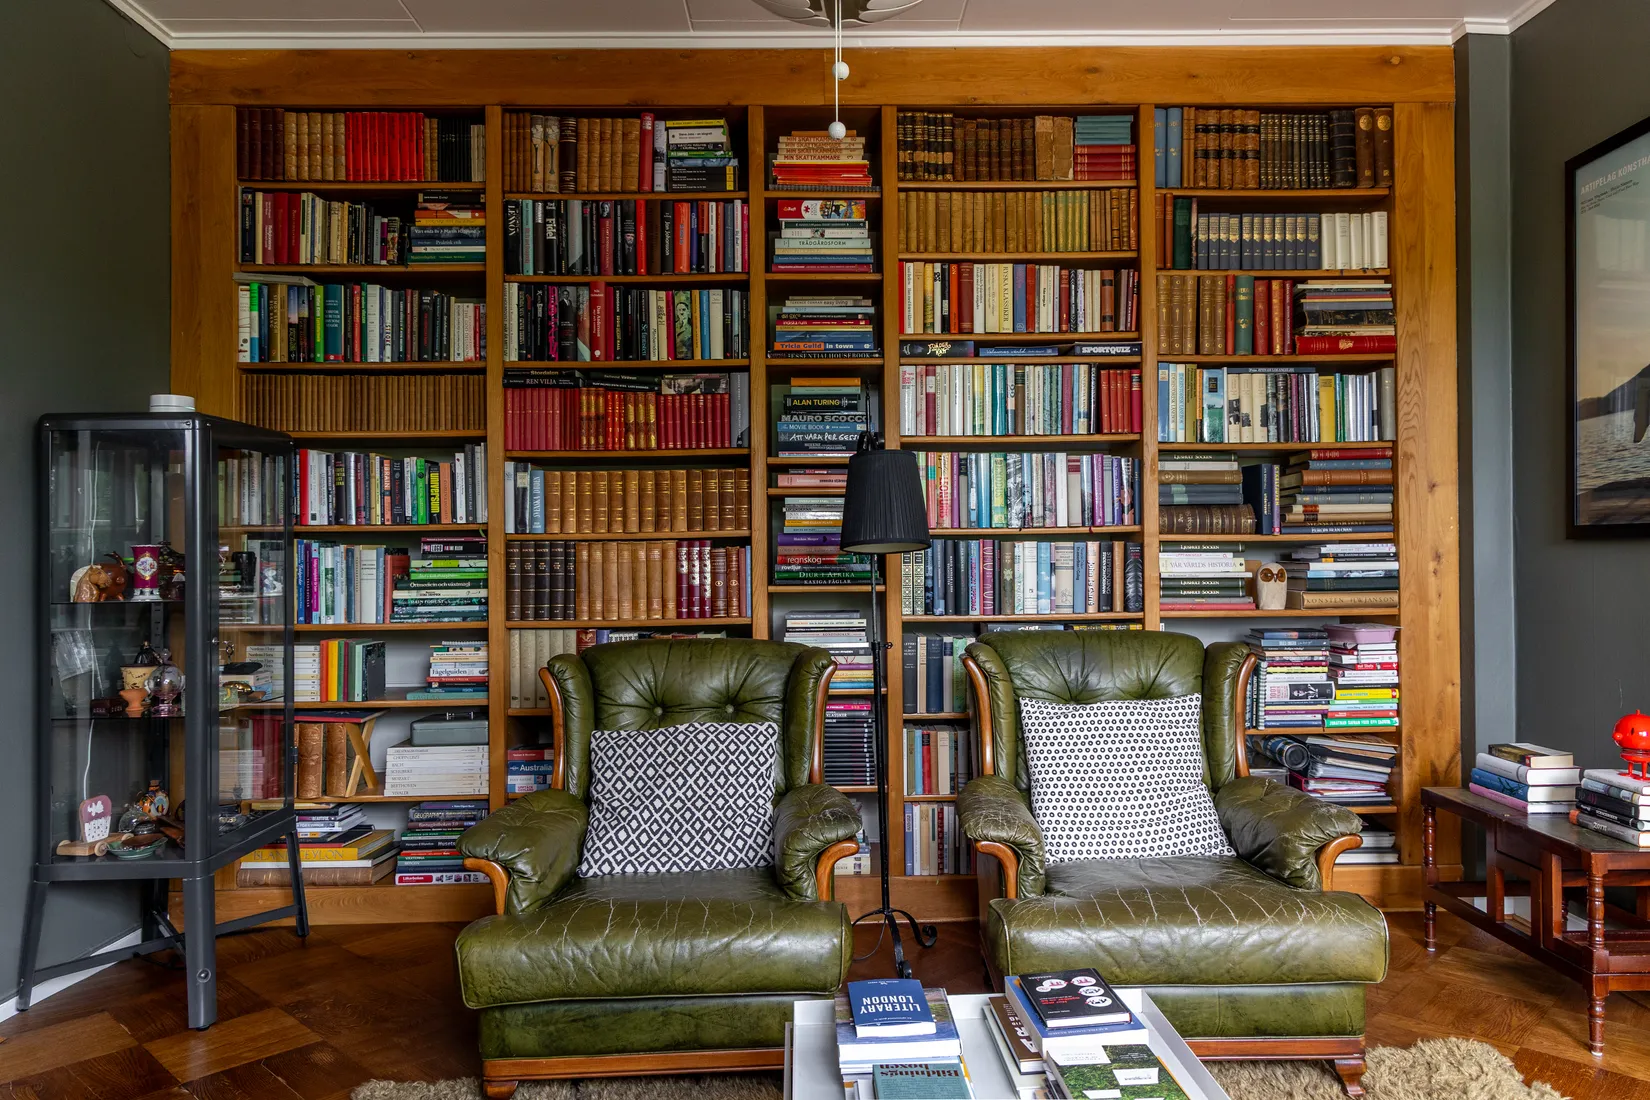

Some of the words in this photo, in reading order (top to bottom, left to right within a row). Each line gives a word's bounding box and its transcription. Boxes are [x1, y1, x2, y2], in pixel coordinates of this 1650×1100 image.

[1580, 171, 1617, 195] ARTIPELAG
[545, 218, 557, 240] Fidel
[1081, 346, 1131, 354] SPORTQUIZ
[780, 414, 823, 422] MAURO
[789, 432, 803, 441] ATT
[804, 432, 822, 441] VARA
[824, 432, 837, 441] PER
[430, 472, 440, 513] universum
[787, 556, 822, 565] regnskog
[1086, 560, 1095, 577] John
[253, 849, 288, 860] ISLAN
[862, 995, 914, 1004] LONDON
[860, 1003, 921, 1015] LITERARY
[880, 1070, 960, 1078] Bildnings
